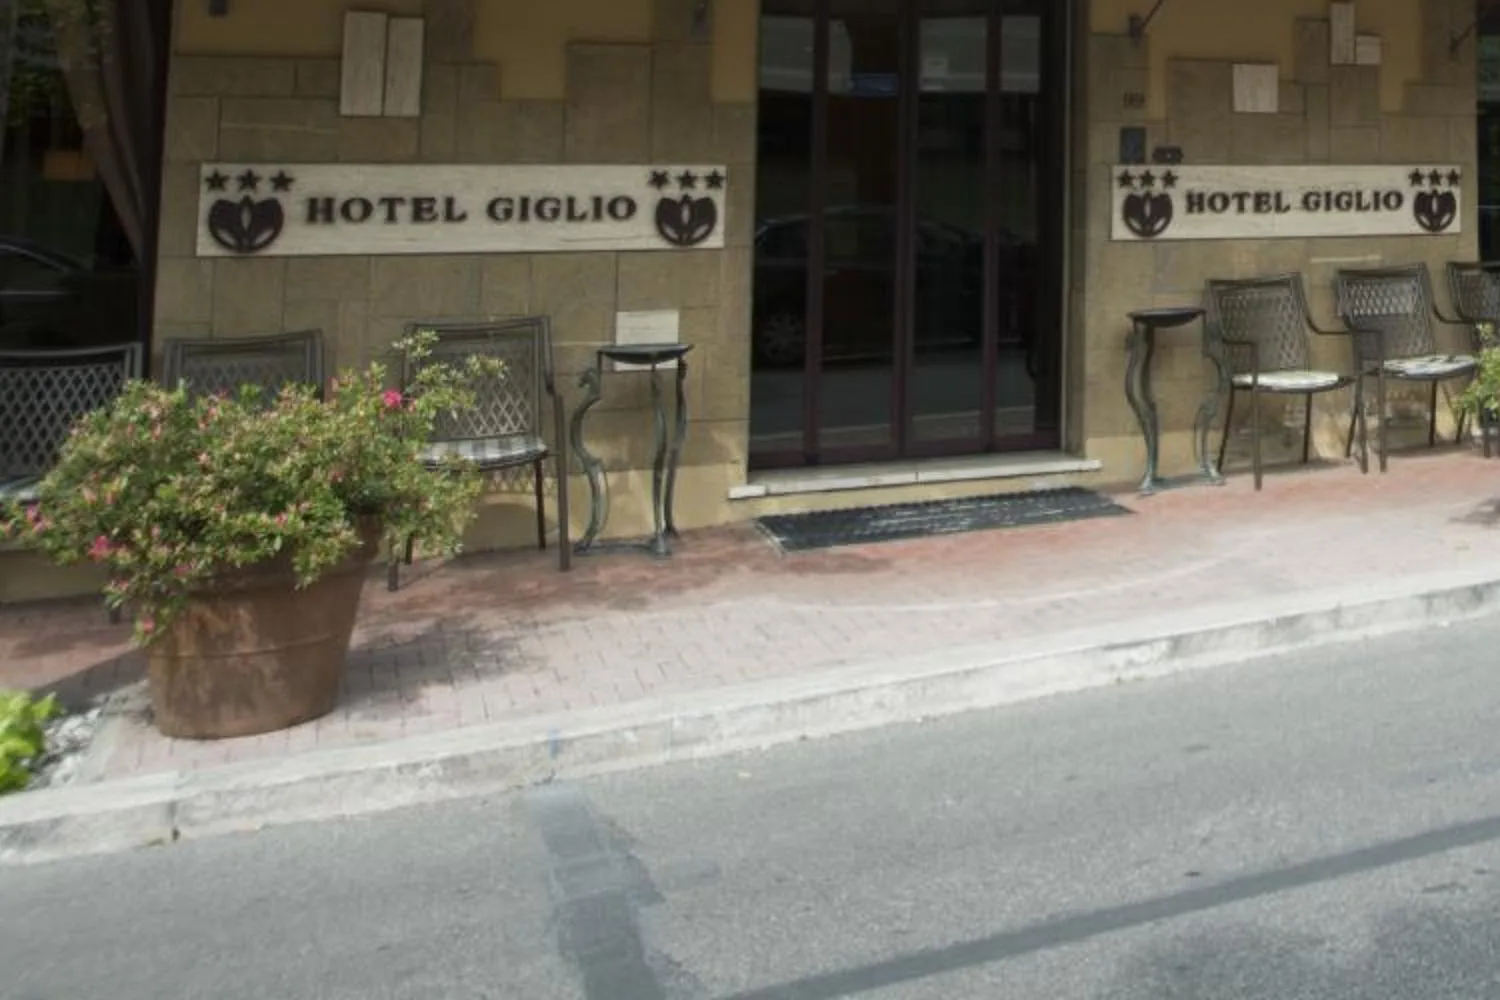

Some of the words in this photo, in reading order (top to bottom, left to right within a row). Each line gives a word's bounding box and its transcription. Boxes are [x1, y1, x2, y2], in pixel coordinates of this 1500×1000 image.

[304, 196, 469, 224] HOTEL
[486, 195, 637, 222] GIGLIO
[1185, 191, 1291, 214] HOTEL
[1302, 190, 1404, 213] GIGLIO
